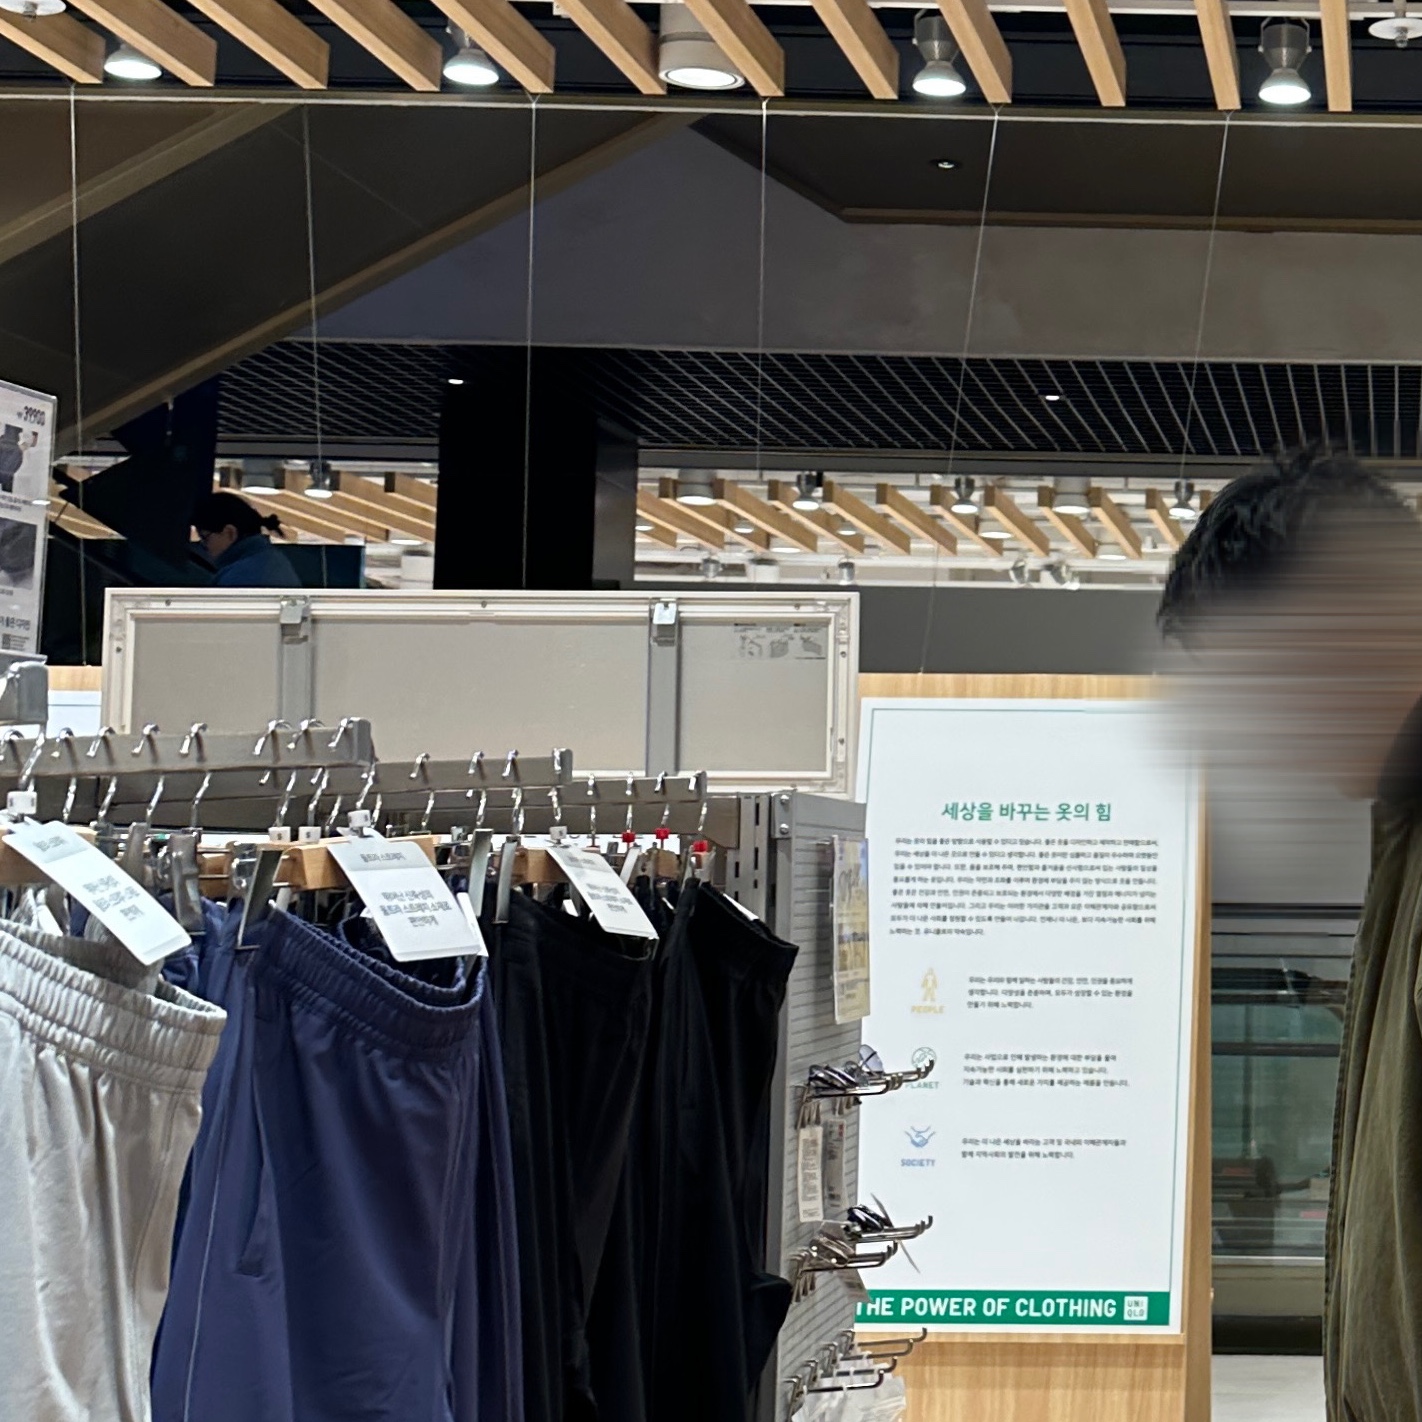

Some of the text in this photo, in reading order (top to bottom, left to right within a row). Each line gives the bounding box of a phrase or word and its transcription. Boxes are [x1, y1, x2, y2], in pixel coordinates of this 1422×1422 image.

[941, 802, 1112, 822] 세상을 바꾸는 옷의 힘
[900, 1159, 936, 1168] SOCIETY
[855, 1298, 1117, 1318] THE POWER OF CLOTHING
[1127, 1300, 1144, 1308] UNI
[1127, 1308, 1145, 1318] QLO
